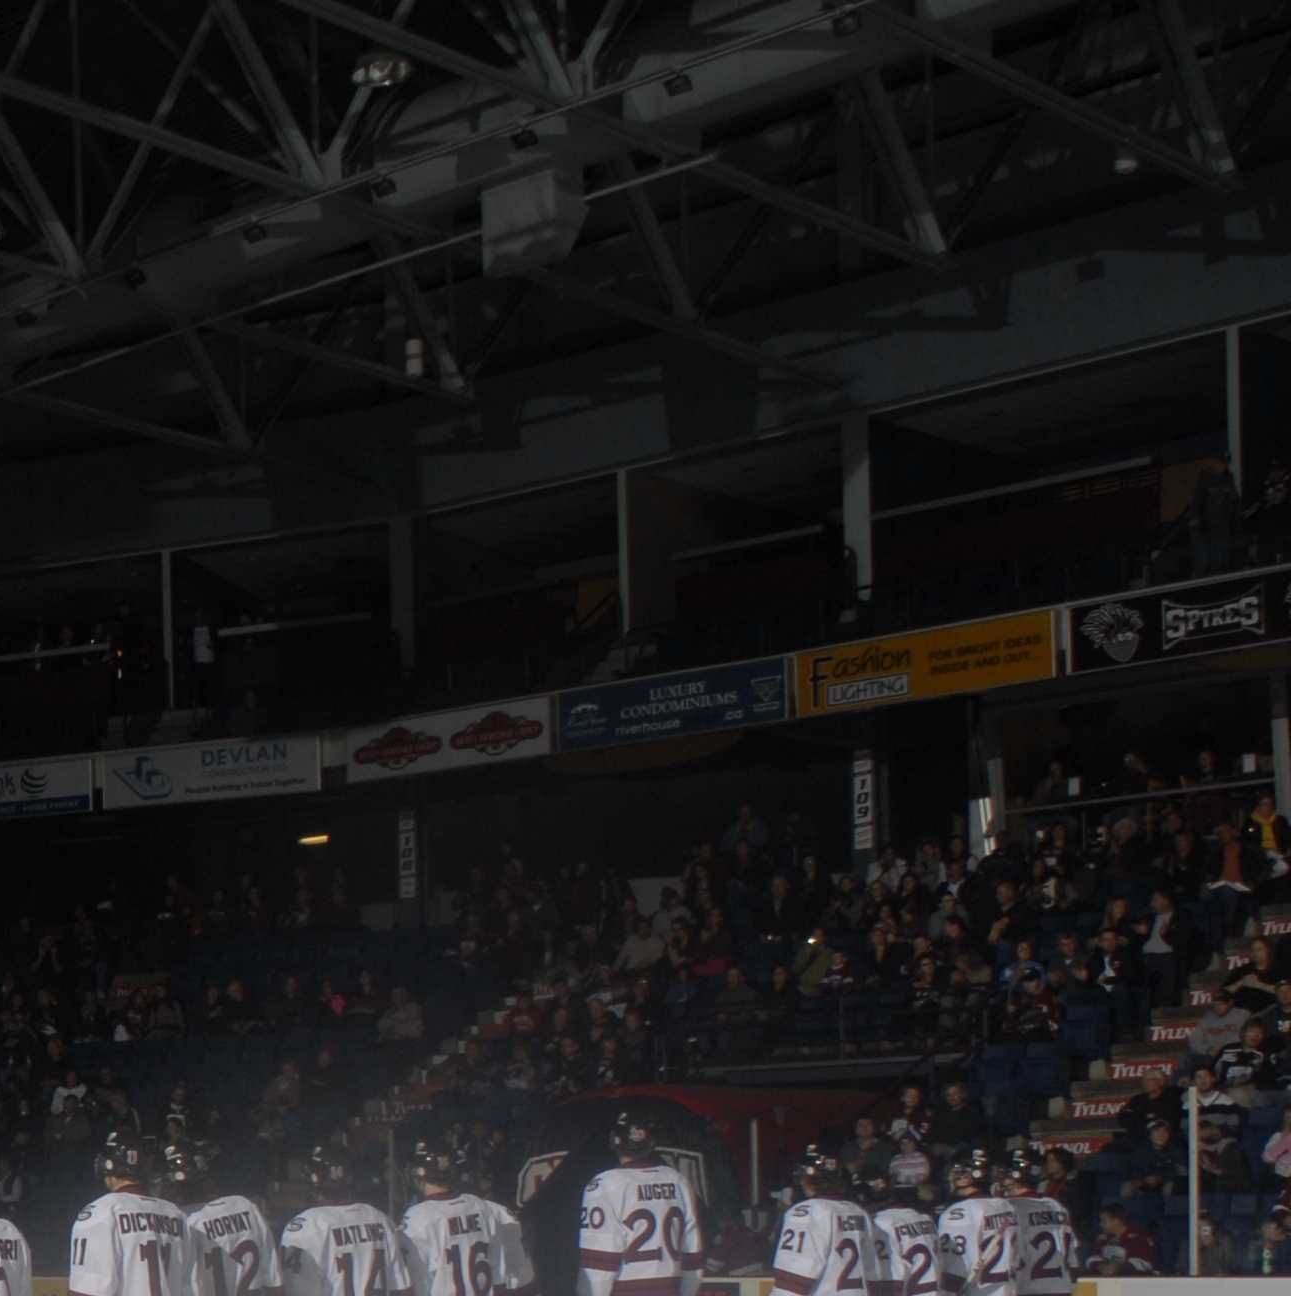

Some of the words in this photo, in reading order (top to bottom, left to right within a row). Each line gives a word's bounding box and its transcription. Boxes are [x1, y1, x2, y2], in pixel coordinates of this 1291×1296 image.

[1166, 596, 1259, 639] SPYKES
[928, 650, 951, 662] FOR
[956, 641, 999, 657] BRIGHT
[1004, 634, 1041, 649] IDEAS
[810, 646, 911, 708] Fashion
[930, 661, 970, 676] INSIDE
[974, 657, 1000, 669] AND
[649, 680, 707, 702] LUXURY
[832, 675, 905, 703] LIGHTING
[620, 691, 738, 720] CONDOMINIUMS
[202, 743, 287, 767] DEVLAN
[201, 767, 270, 779] CONSTRUCTION
[272, 764, 287, 773] LTD
[185, 787, 210, 795] People
[213, 783, 241, 793] Building
[275, 777, 306, 787] Together
[22, 803, 47, 813] HOME
[50, 799, 79, 810] PHONE
[637, 1183, 677, 1201] AUGER
[204, 1211, 252, 1241] HORVAT
[332, 1222, 385, 1248] WATLING
[622, 1206, 686, 1267] 20
[73, 1238, 88, 1267] 11
[781, 1228, 805, 1254] 21
